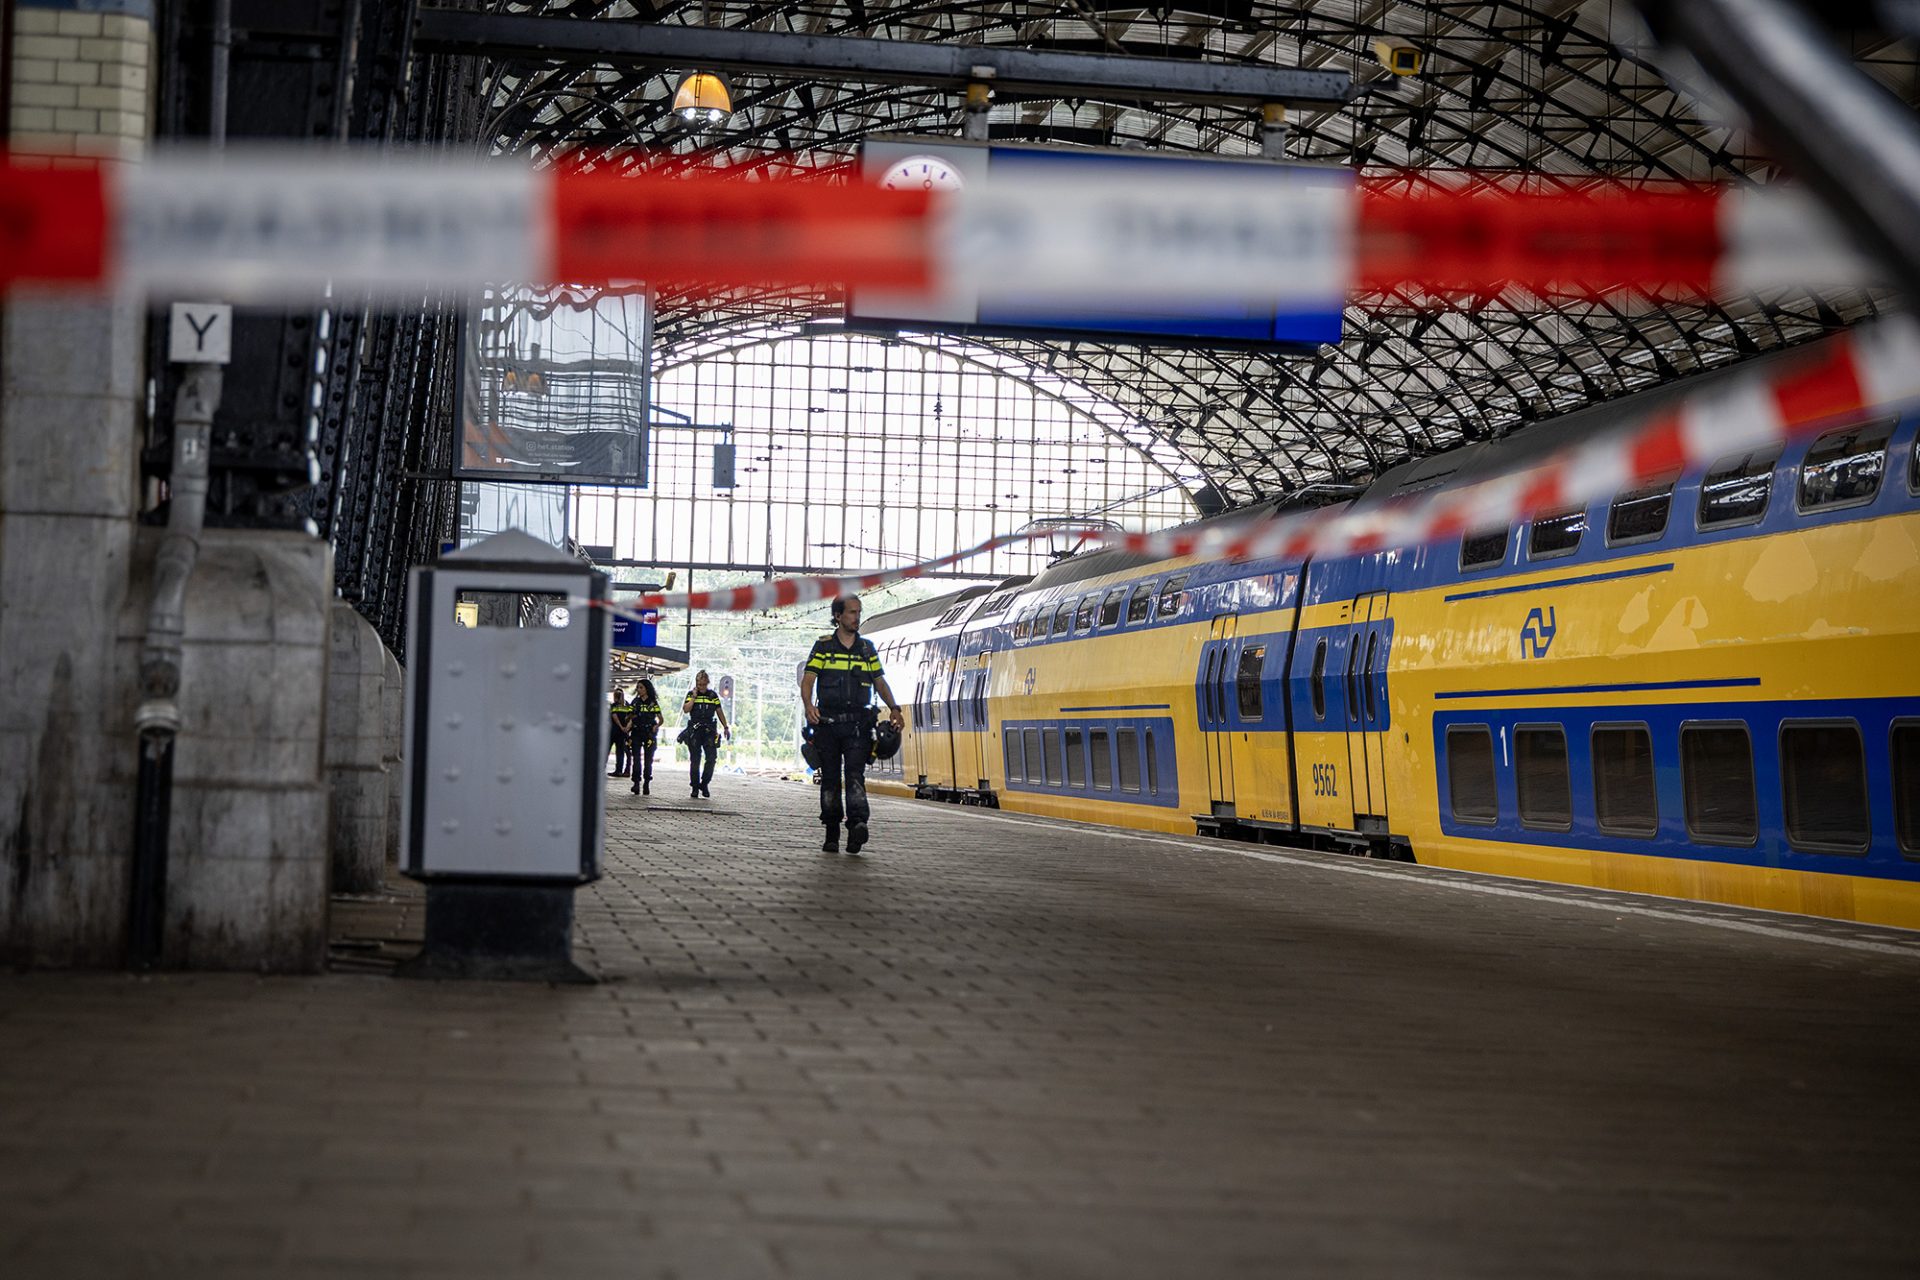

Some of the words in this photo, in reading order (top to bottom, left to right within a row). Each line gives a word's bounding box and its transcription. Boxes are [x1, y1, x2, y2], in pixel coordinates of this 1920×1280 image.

[185, 312, 219, 352] Y
[1514, 524, 1524, 566] 1
[1500, 726, 1508, 767] 1
[1312, 763, 1338, 797] 9562
